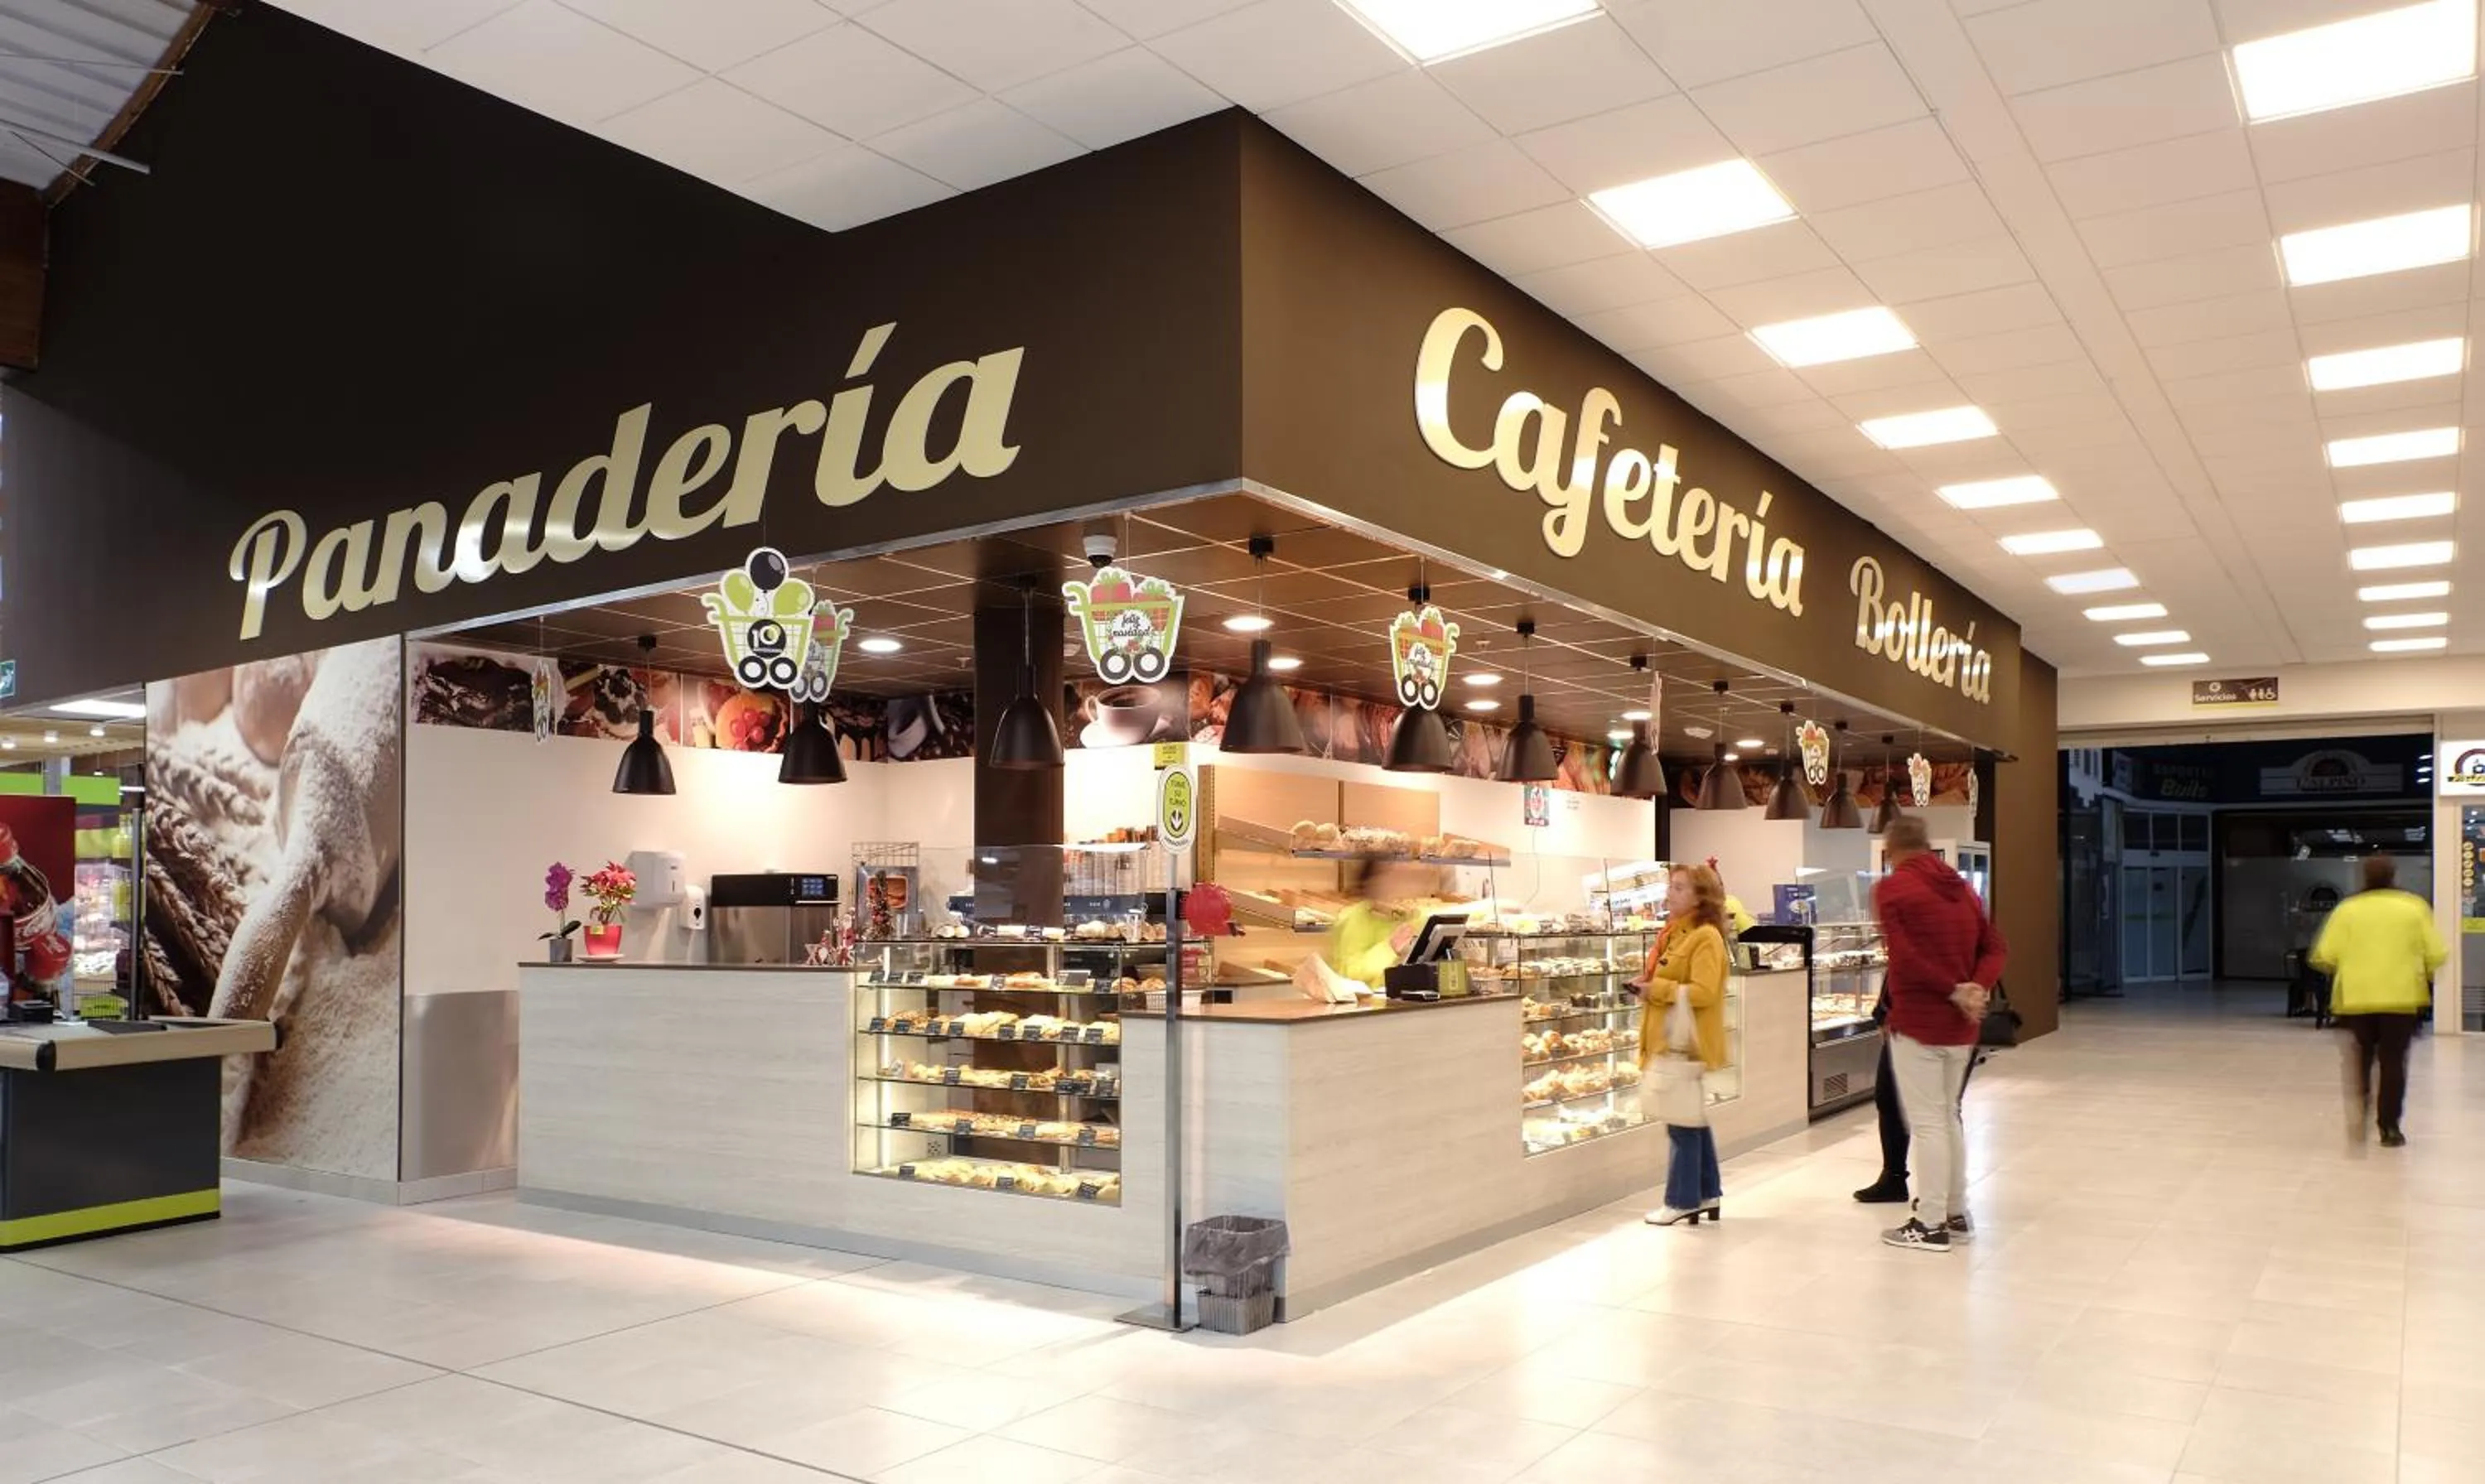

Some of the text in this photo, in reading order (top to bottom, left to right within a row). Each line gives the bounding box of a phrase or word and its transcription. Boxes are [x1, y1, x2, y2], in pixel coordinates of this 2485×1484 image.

[229, 321, 1025, 640] Panadería
[1414, 307, 1806, 618] Cafetería
[1850, 556, 1991, 705] Bollería
[2194, 692, 2237, 703] Servicios
